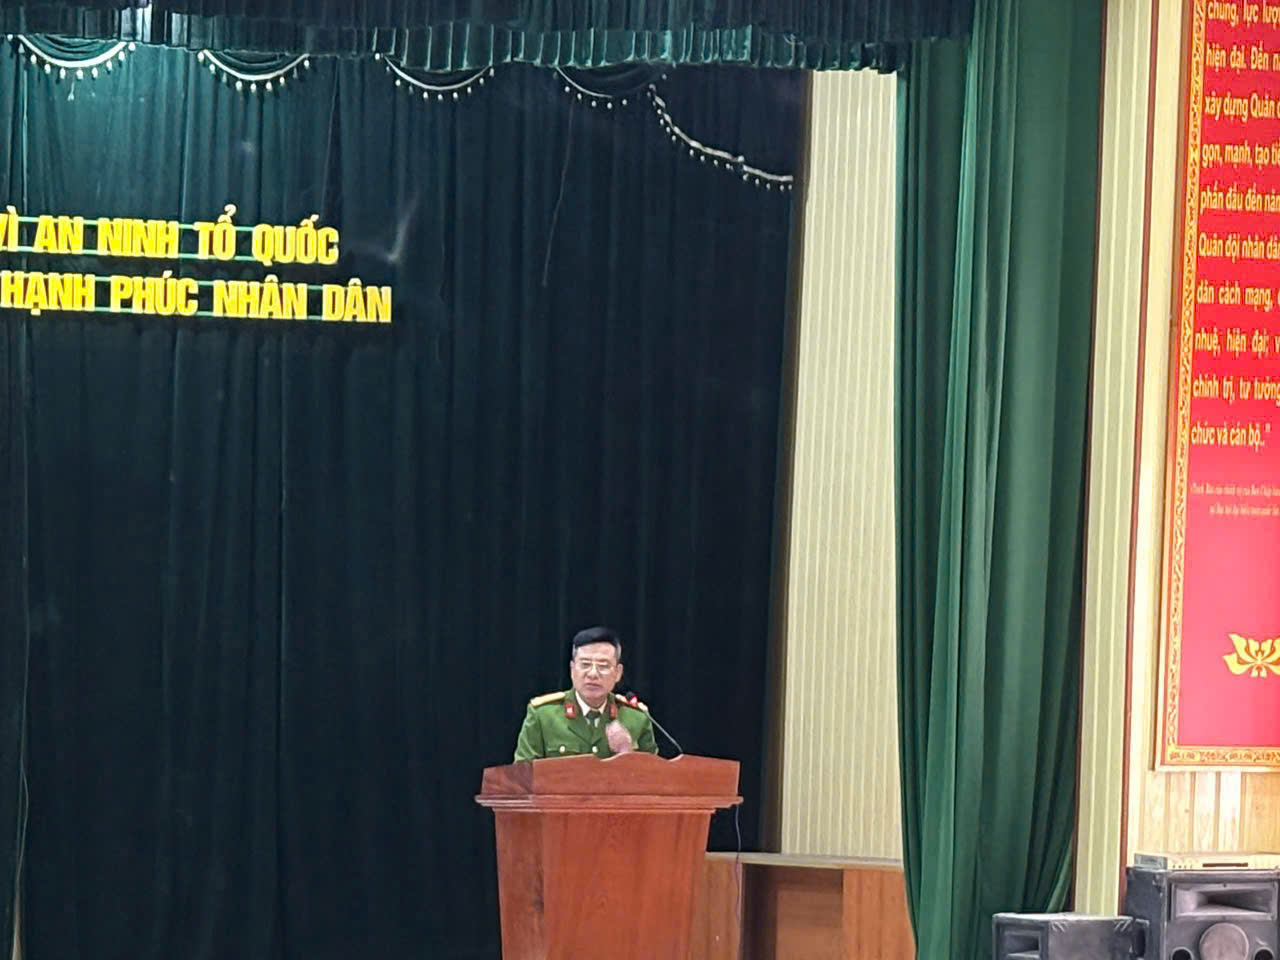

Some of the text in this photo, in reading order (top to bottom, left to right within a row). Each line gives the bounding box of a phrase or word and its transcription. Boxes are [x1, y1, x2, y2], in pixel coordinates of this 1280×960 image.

[1206, 42, 1226, 72] hiện
[1251, 40, 1269, 71] Đến
[1205, 91, 1221, 121] xây
[1223, 91, 1248, 122] dựng
[1251, 93, 1275, 118] Quân
[1255, 142, 1270, 170] tạo
[1200, 180, 1223, 214] phấn
[1226, 181, 1243, 210] đấu
[1245, 182, 1262, 211] đến
[34, 216, 83, 255] AN
[98, 218, 179, 258] NINH
[194, 205, 236, 261] TỔ
[252, 214, 339, 266] QUỐC
[1199, 232, 1223, 257] Quân
[1225, 232, 1240, 263] đội
[1242, 233, 1265, 259] nhân
[1, 268, 95, 315] HẠNH
[110, 271, 198, 316] PHÚC
[213, 274, 308, 320] NHÂN
[322, 278, 392, 324] DÂN
[1197, 279, 1215, 304] dân
[1218, 280, 1241, 305] cách
[1226, 327, 1247, 359] hiện
[1193, 373, 1218, 398] chính
[1239, 376, 1251, 399] tư
[1191, 421, 1215, 445] chức
[1216, 421, 1228, 445] và
[1229, 421, 1246, 446] cán
